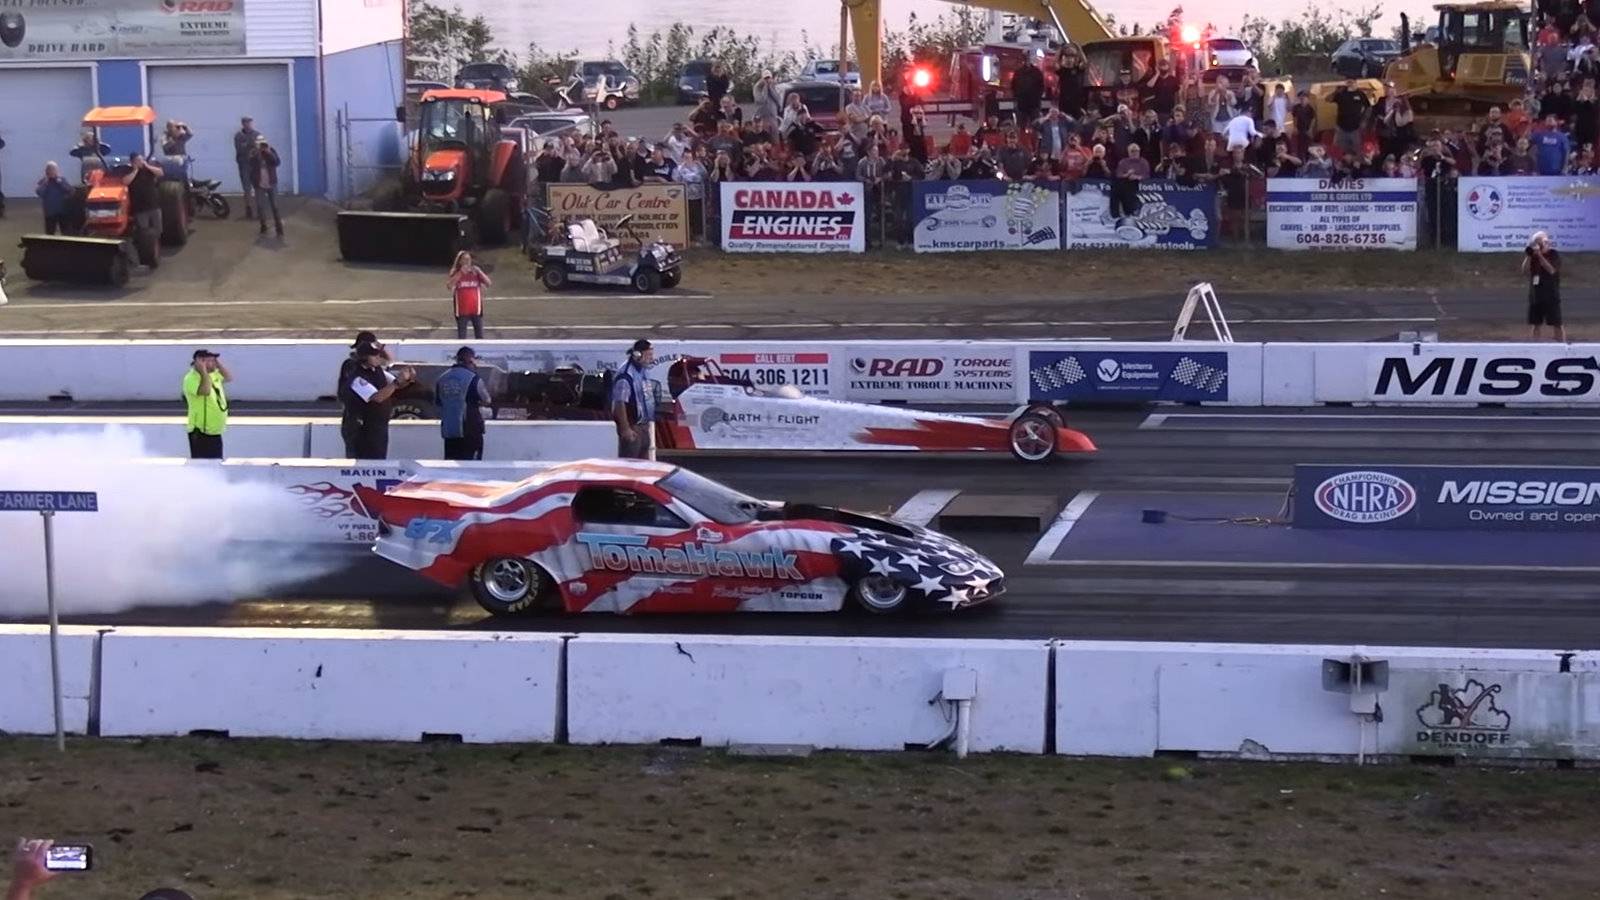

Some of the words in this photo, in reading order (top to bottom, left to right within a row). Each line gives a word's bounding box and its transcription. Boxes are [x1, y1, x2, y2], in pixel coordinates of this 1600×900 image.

[28, 43, 64, 53] DRIVE
[71, 43, 105, 52] HARD
[1319, 180, 1364, 189] DAVIES
[562, 192, 589, 211] Old
[627, 192, 671, 210] Centre
[734, 190, 836, 209] CANADA
[742, 215, 842, 236] ENGINES
[1297, 234, 1386, 244] 604-826-6736
[728, 241, 754, 250] Quality
[756, 241, 817, 249] Remanufactured
[820, 241, 850, 250] Engines
[868, 358, 944, 377] RAD
[953, 358, 1012, 367] TORQUE
[1122, 371, 1160, 379] Equipment
[851, 381, 903, 389] EXTREME
[907, 381, 950, 390] TORQUE
[954, 381, 1012, 389] MACHINES
[721, 413, 761, 422] EARTH
[777, 415, 820, 424] FLIGHT
[341, 469, 387, 477] MAKIN
[1334, 473, 1399, 486] CHAMPIONSHIP
[58, 494, 95, 509] LANE
[1333, 482, 1399, 512] NHRA
[1332, 509, 1359, 520] DRAG
[1361, 509, 1397, 520] RACING
[1469, 510, 1525, 521] Owned
[1530, 510, 1559, 521] and
[576, 532, 804, 580] TomaHawk
[780, 591, 823, 600] TOPGUN
[1417, 732, 1510, 744] DENDOFF
